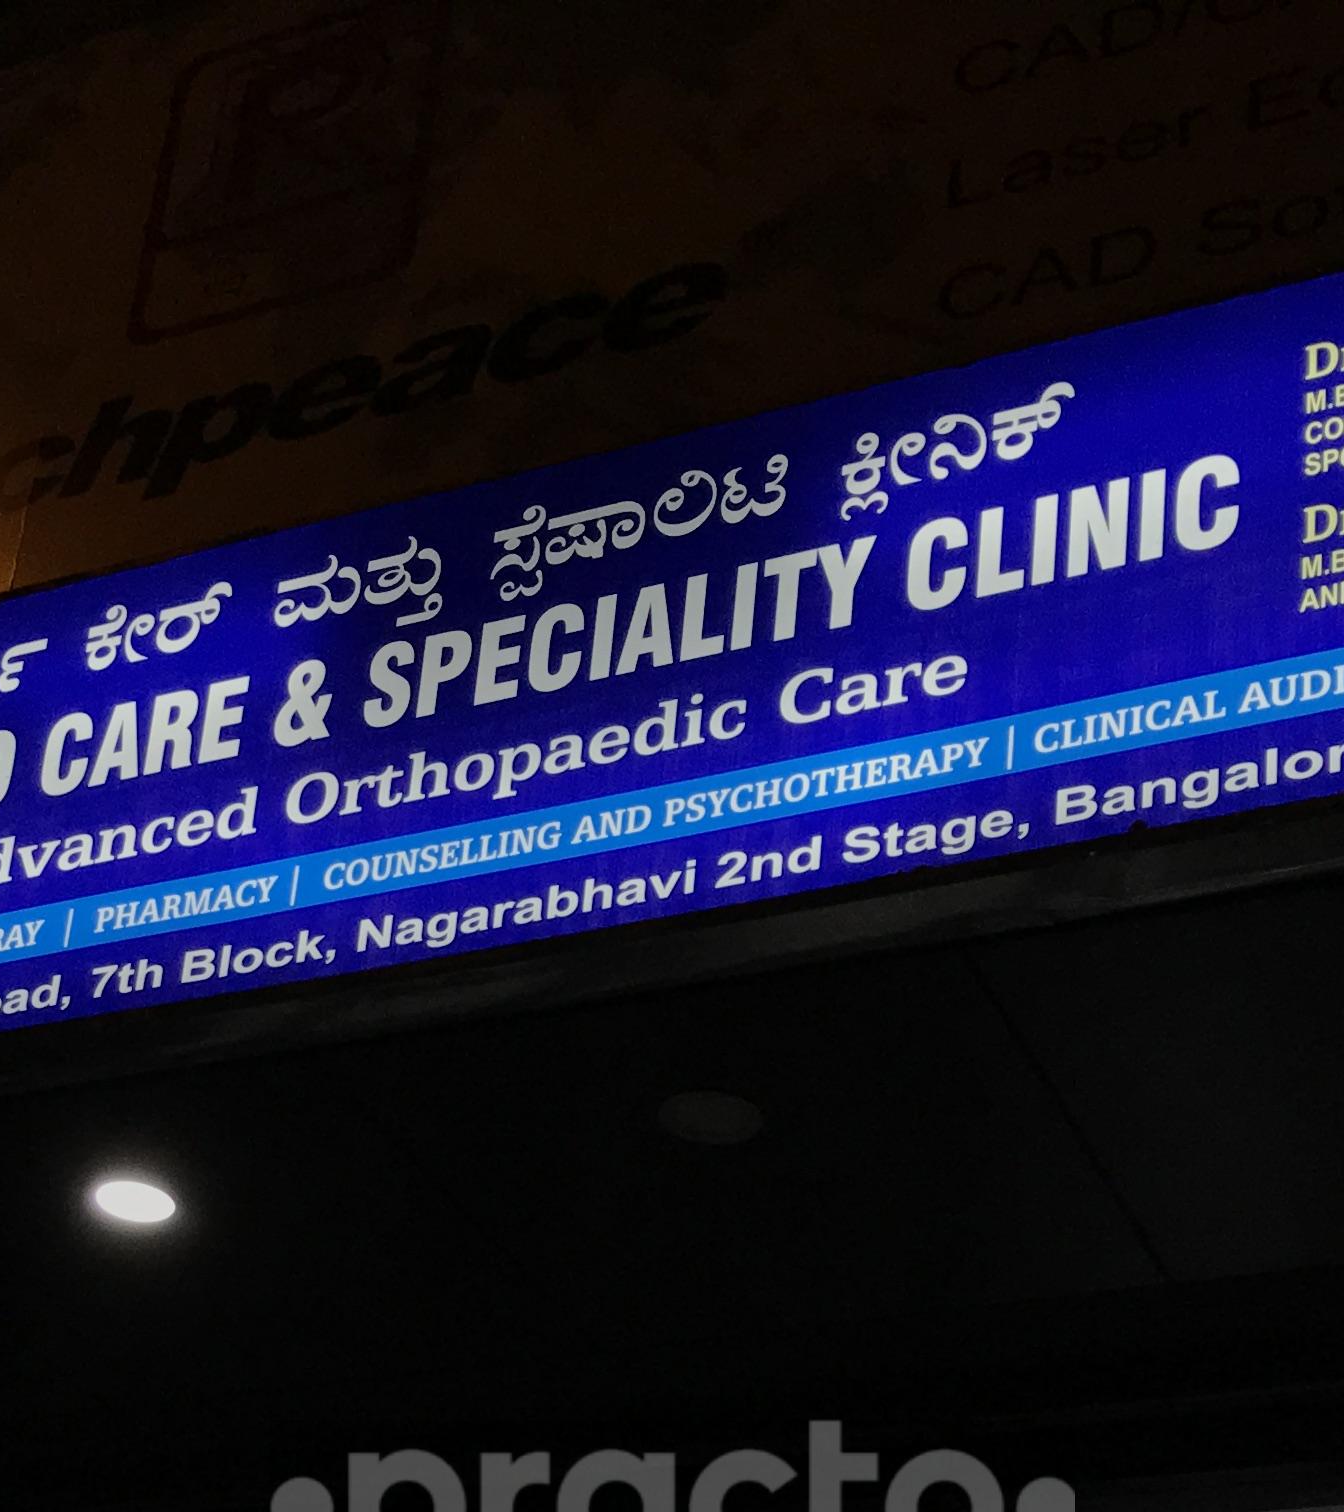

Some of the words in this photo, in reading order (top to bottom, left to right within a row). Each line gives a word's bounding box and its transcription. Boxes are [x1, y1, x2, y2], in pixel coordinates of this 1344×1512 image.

[40, 675, 251, 796] CARE
[273, 659, 333, 747] &
[363, 534, 878, 728] SPECIALITY
[906, 454, 1240, 611] CLINIC
[85, 581, 233, 671] ಕೇರ್
[273, 535, 443, 628] ಮತ್ತು
[490, 454, 789, 602] ಸ್ಪೆಷಾಲಿಟಿ
[840, 381, 1076, 521] ಕ್ಲೀನಿಕ್
[94, 875, 279, 933] PHARMACY
[323, 821, 562, 890] COUNSELLING
[570, 805, 652, 845] AND
[662, 737, 990, 827] PSYCHOTHERAPY
[1034, 690, 1226, 753] CLINICAL
[285, 693, 747, 825] Orthopaedic
[779, 655, 968, 725] Care
[92, 958, 164, 999] 7th
[180, 929, 336, 984] Block,
[356, 859, 697, 953] Nagarabhavi
[714, 834, 823, 889] 2nd
[842, 809, 1030, 864] Stage,
